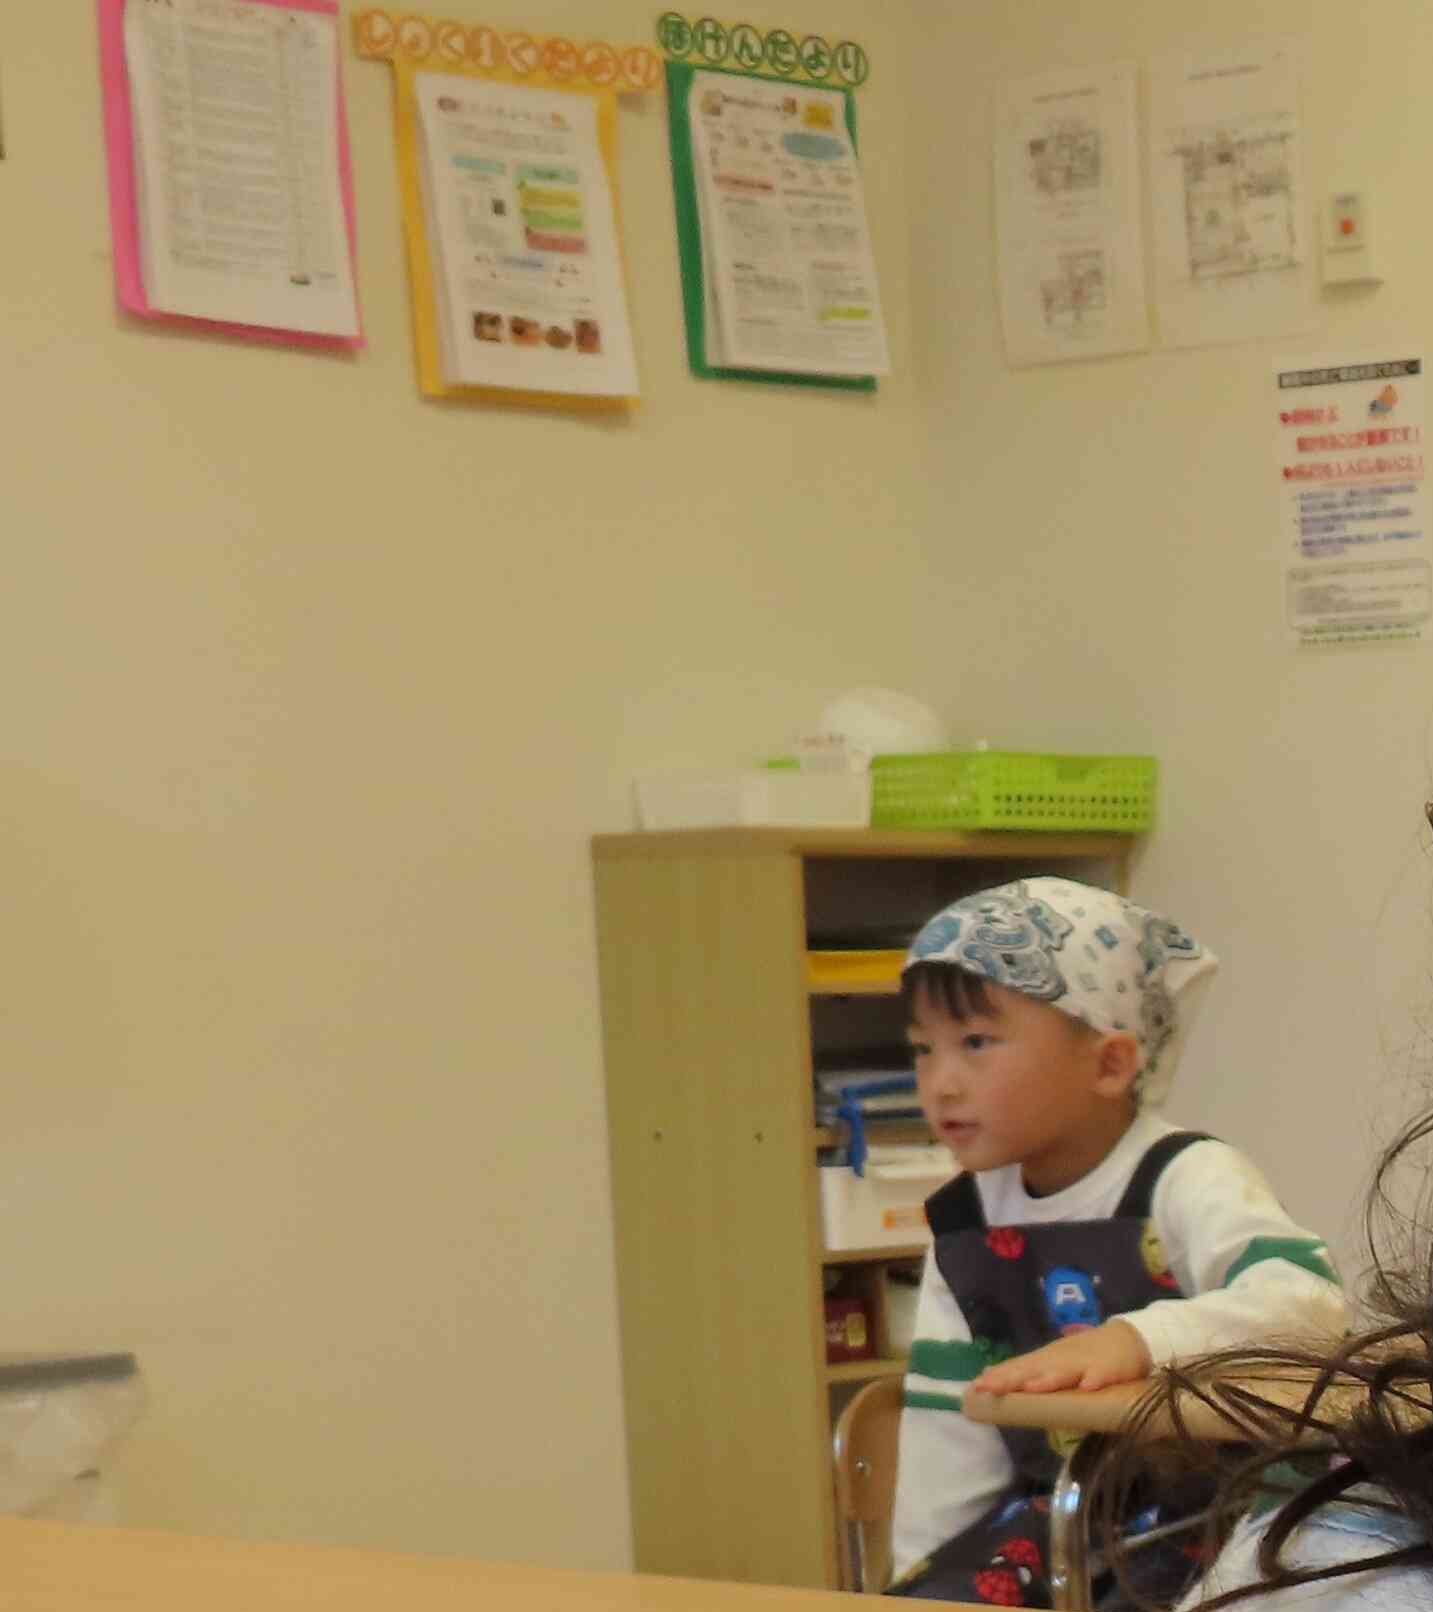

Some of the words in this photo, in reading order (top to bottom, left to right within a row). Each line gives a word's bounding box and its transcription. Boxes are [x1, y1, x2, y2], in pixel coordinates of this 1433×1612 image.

[657, 12, 869, 86] ほけんだより
[1056, 1284, 1086, 1304] A
